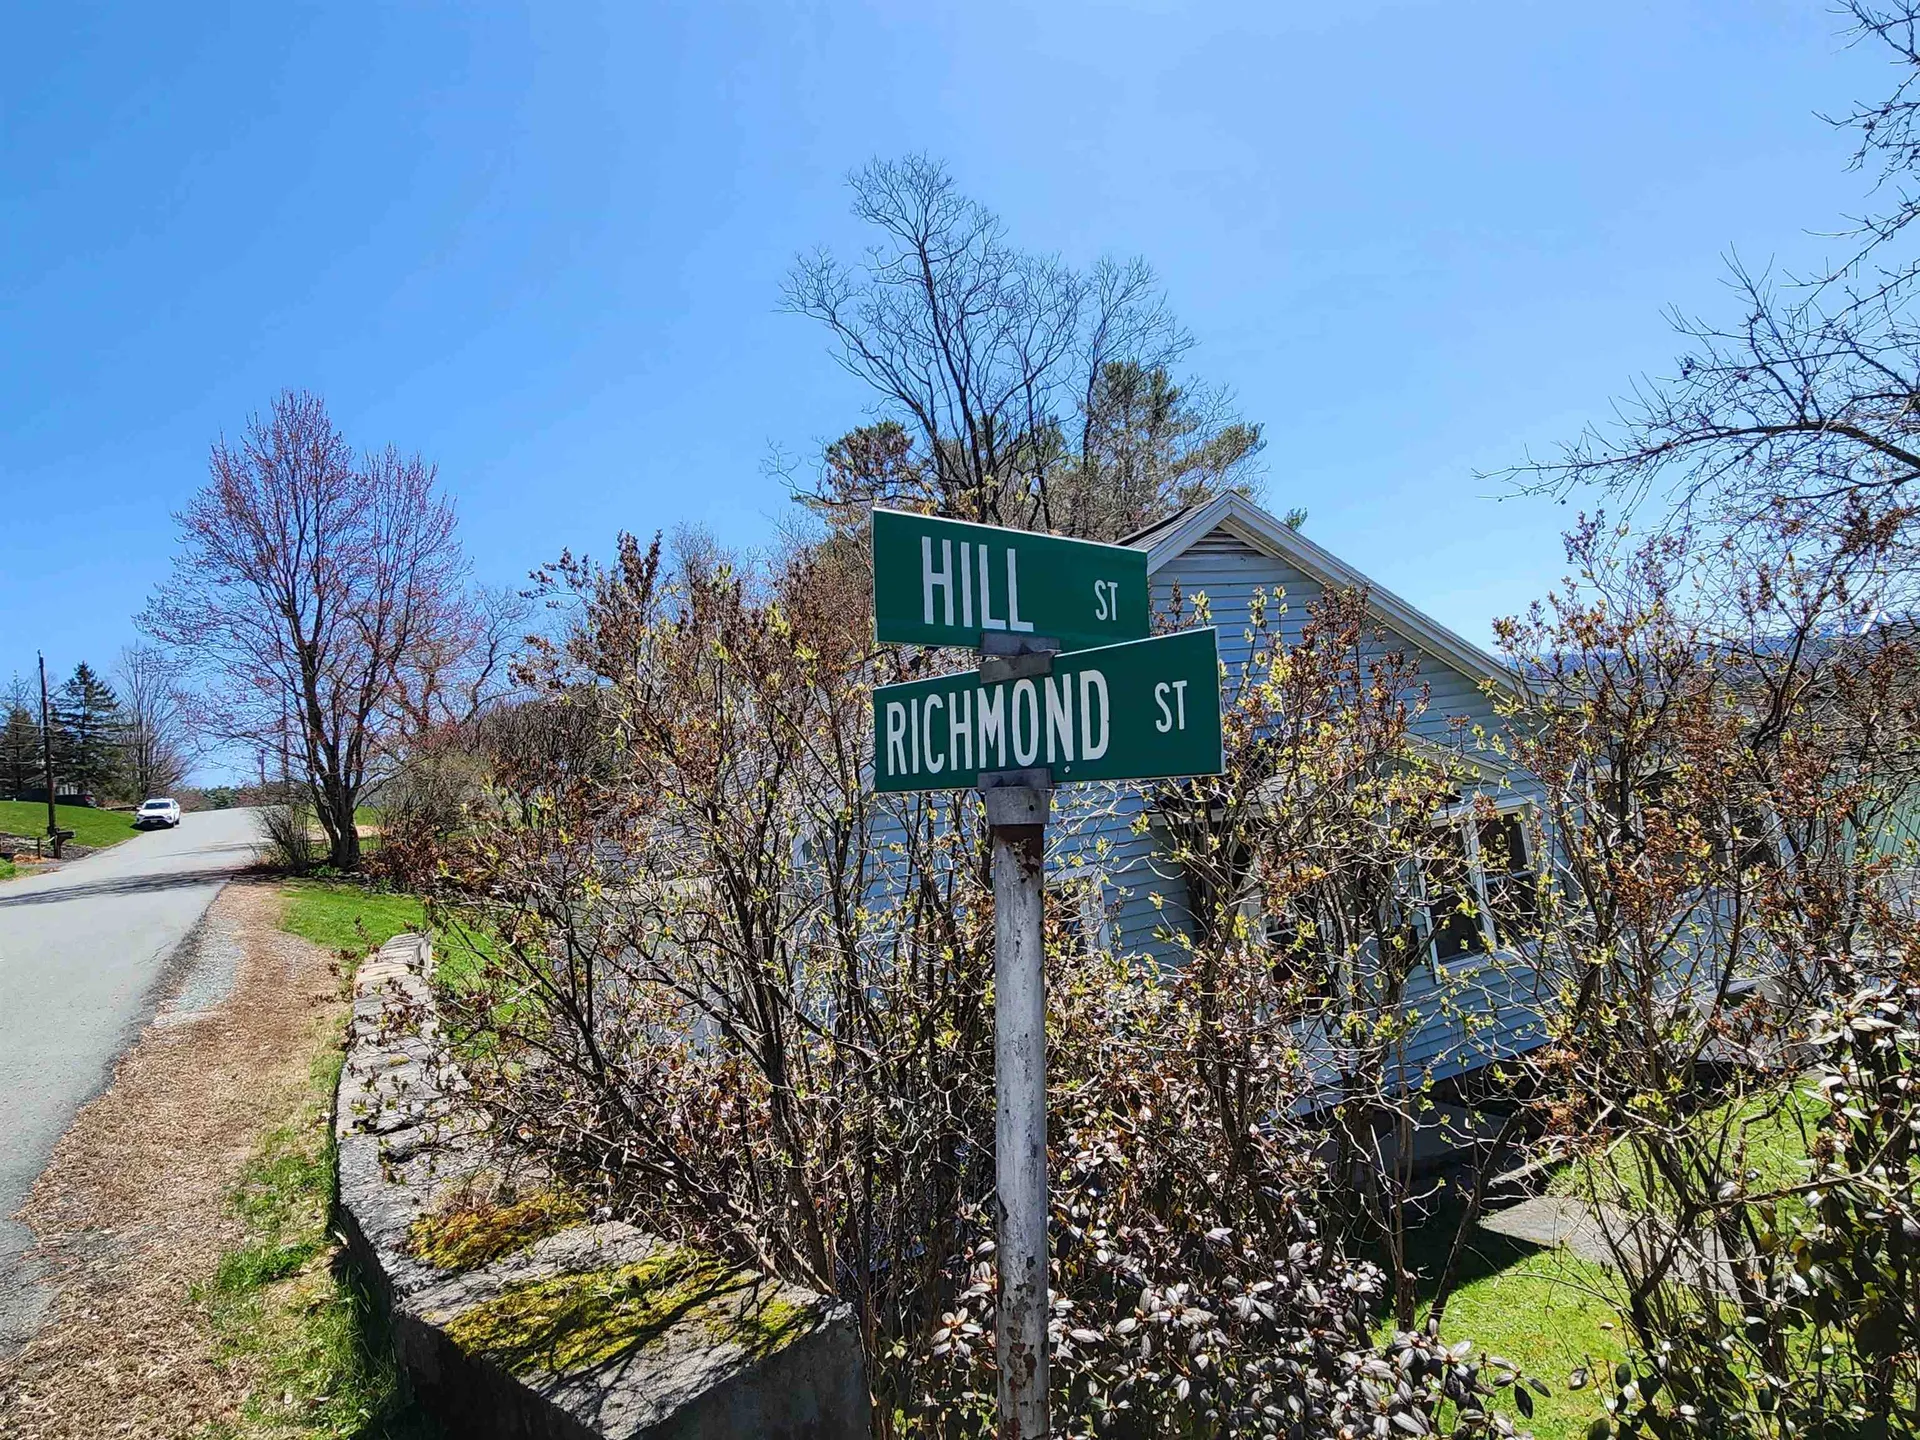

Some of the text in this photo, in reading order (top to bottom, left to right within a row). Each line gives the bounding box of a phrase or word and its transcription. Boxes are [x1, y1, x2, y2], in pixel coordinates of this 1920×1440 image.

[921, 536, 1119, 632] HILL ST
[886, 669, 1188, 776] RICHMOND ST
